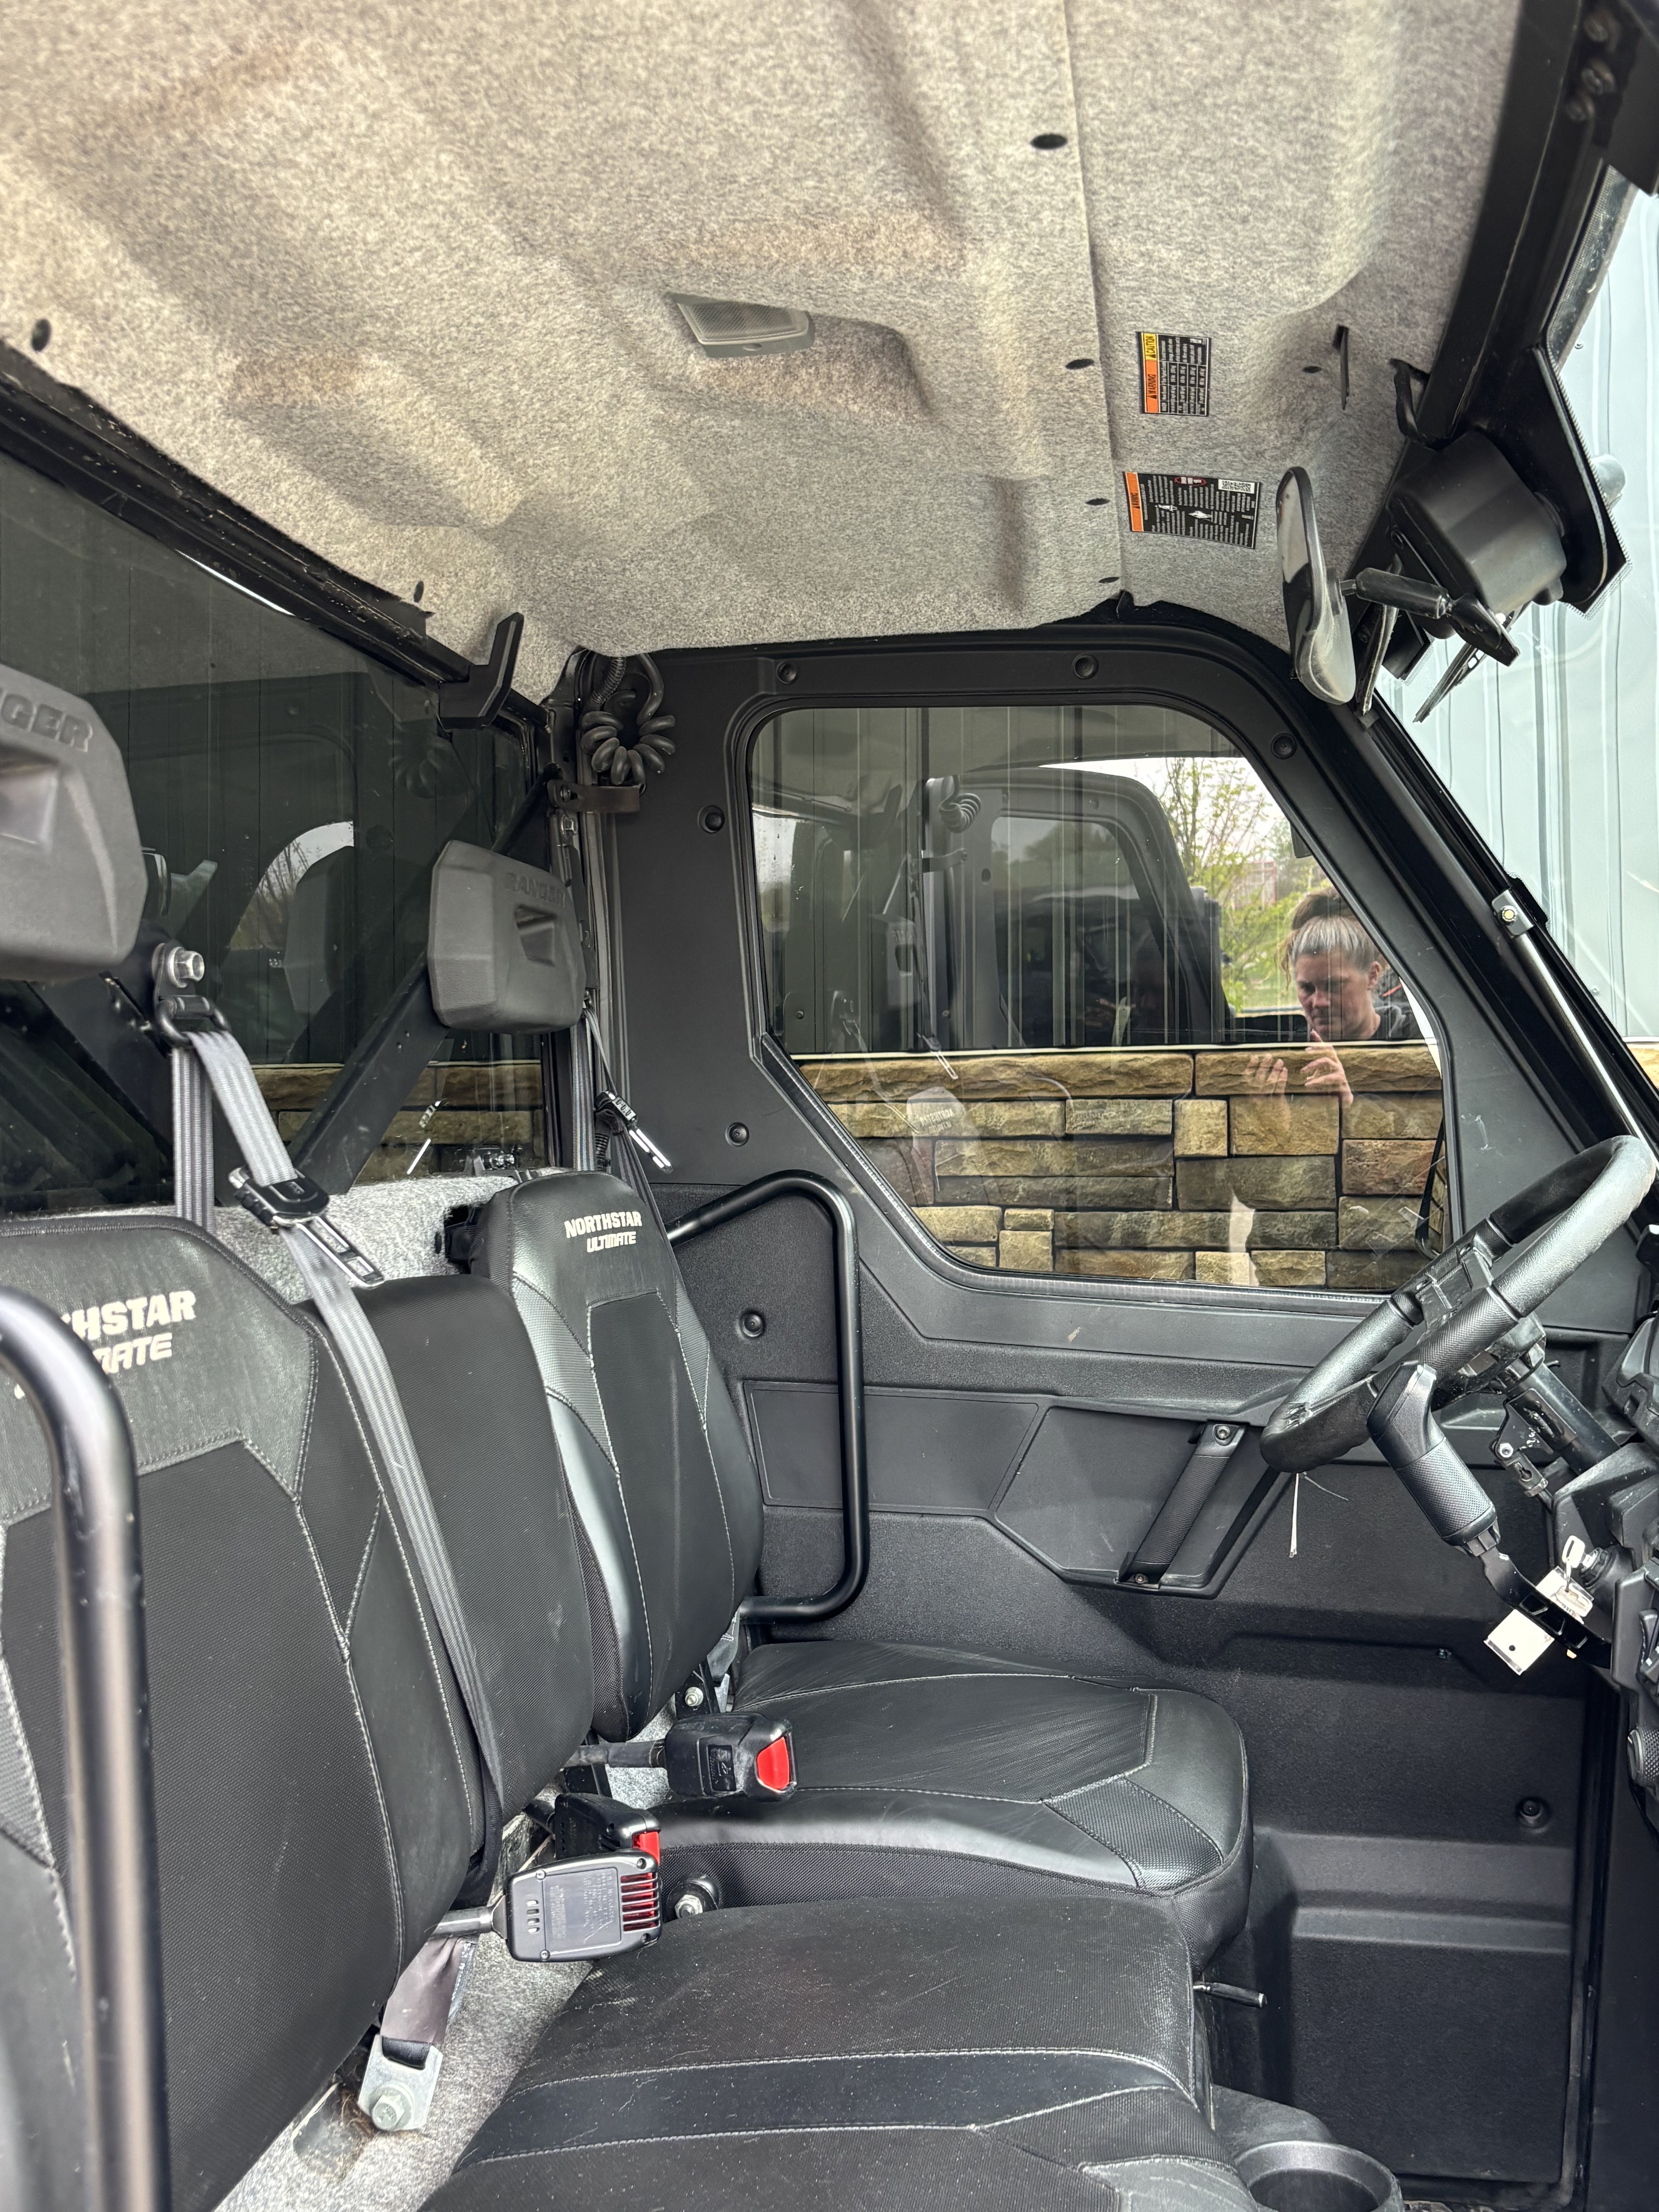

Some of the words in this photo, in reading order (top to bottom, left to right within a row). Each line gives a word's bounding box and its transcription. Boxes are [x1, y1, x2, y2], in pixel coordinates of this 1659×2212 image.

[1146, 336, 1156, 354] CAUTION
[1147, 374, 1157, 395] WARNING
[0, 692, 93, 752] GER
[564, 1211, 642, 1238] NORTHSTAR
[586, 1231, 636, 1253] ULTIMATE
[61, 1290, 196, 1341] HSTAR
